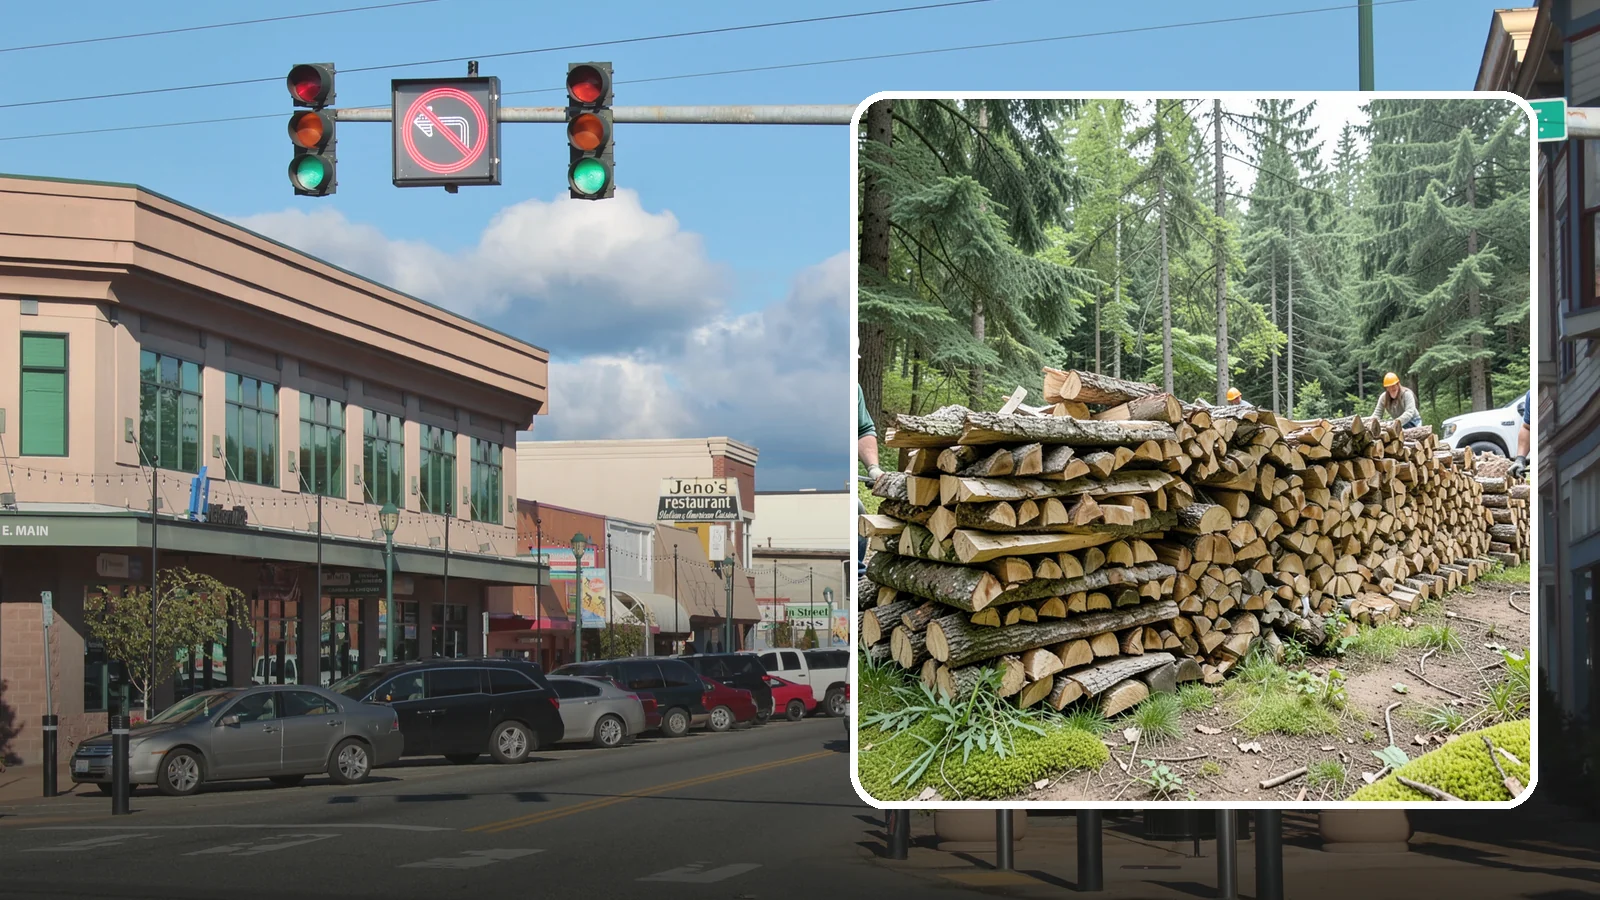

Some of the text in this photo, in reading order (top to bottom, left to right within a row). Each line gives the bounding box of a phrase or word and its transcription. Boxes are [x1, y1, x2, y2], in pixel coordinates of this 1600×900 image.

[669, 479, 727, 495] Jeno's
[665, 496, 731, 509] restaurant
[658, 510, 682, 520] Italian
[686, 509, 714, 520] American
[714, 509, 738, 520] Cuisine
[2, 525, 49, 537] E. MAIN
[797, 607, 829, 617] Street
